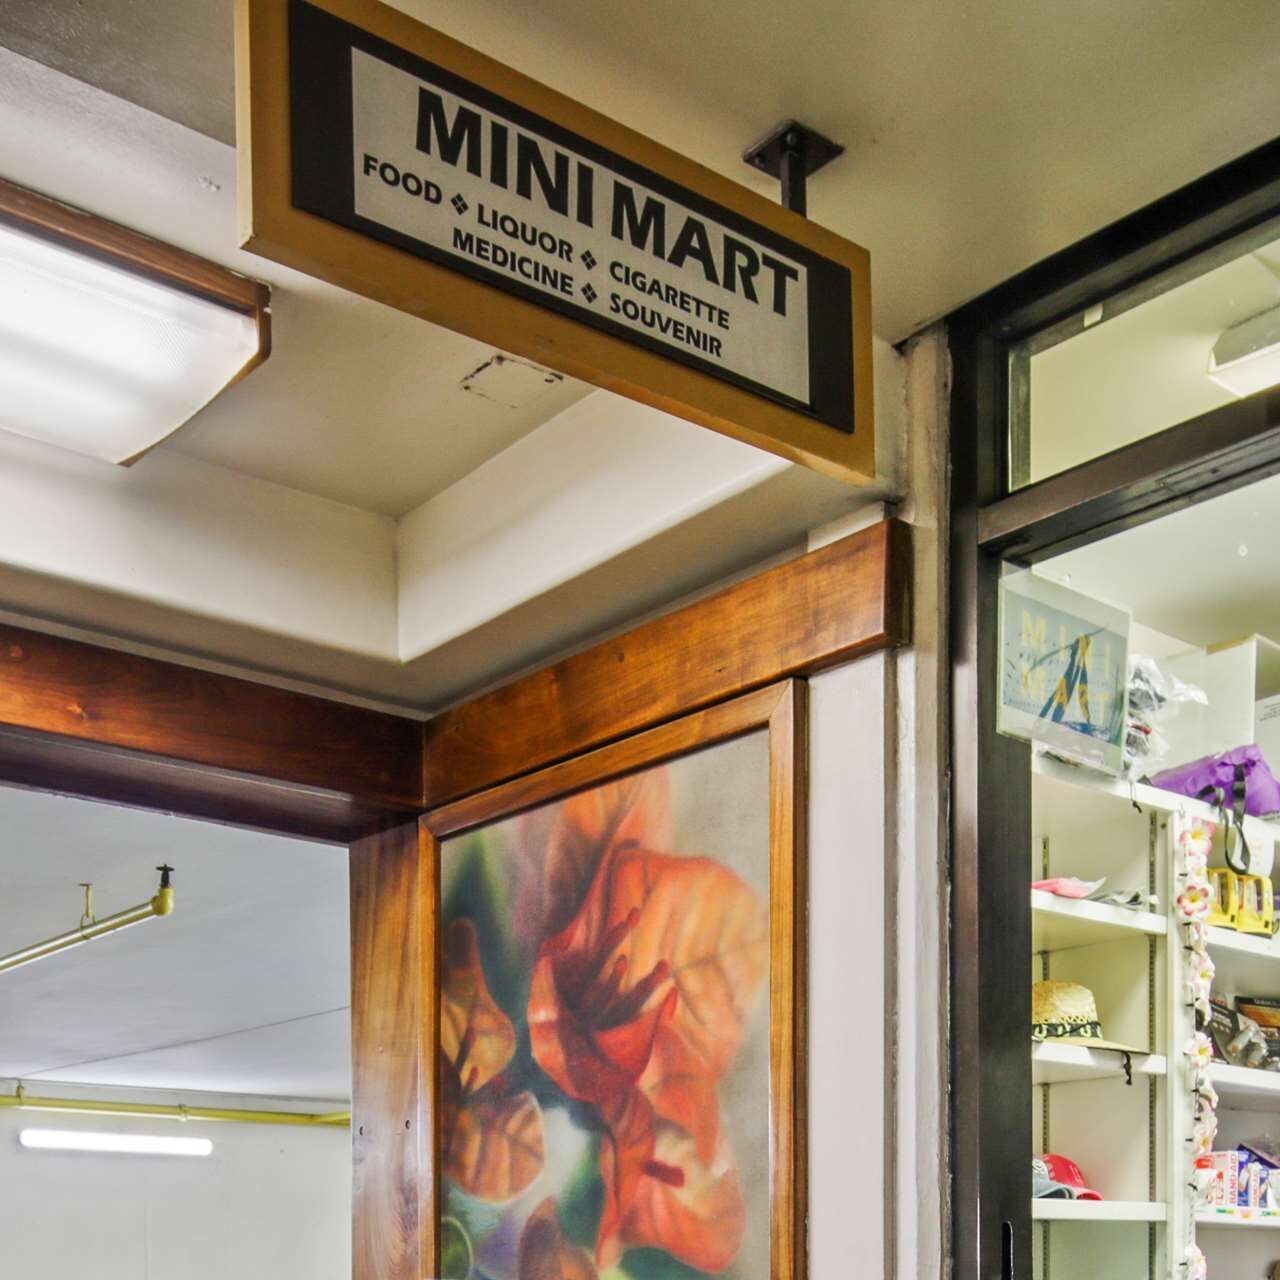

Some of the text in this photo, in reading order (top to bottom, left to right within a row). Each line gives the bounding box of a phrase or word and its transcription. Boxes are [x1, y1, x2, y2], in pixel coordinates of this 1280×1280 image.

[363, 153, 730, 330] FOOD LIQUOR CIGARETTE
[416, 86, 799, 317] MINI MART
[453, 227, 722, 358] MEDICINE SOUVENIR
